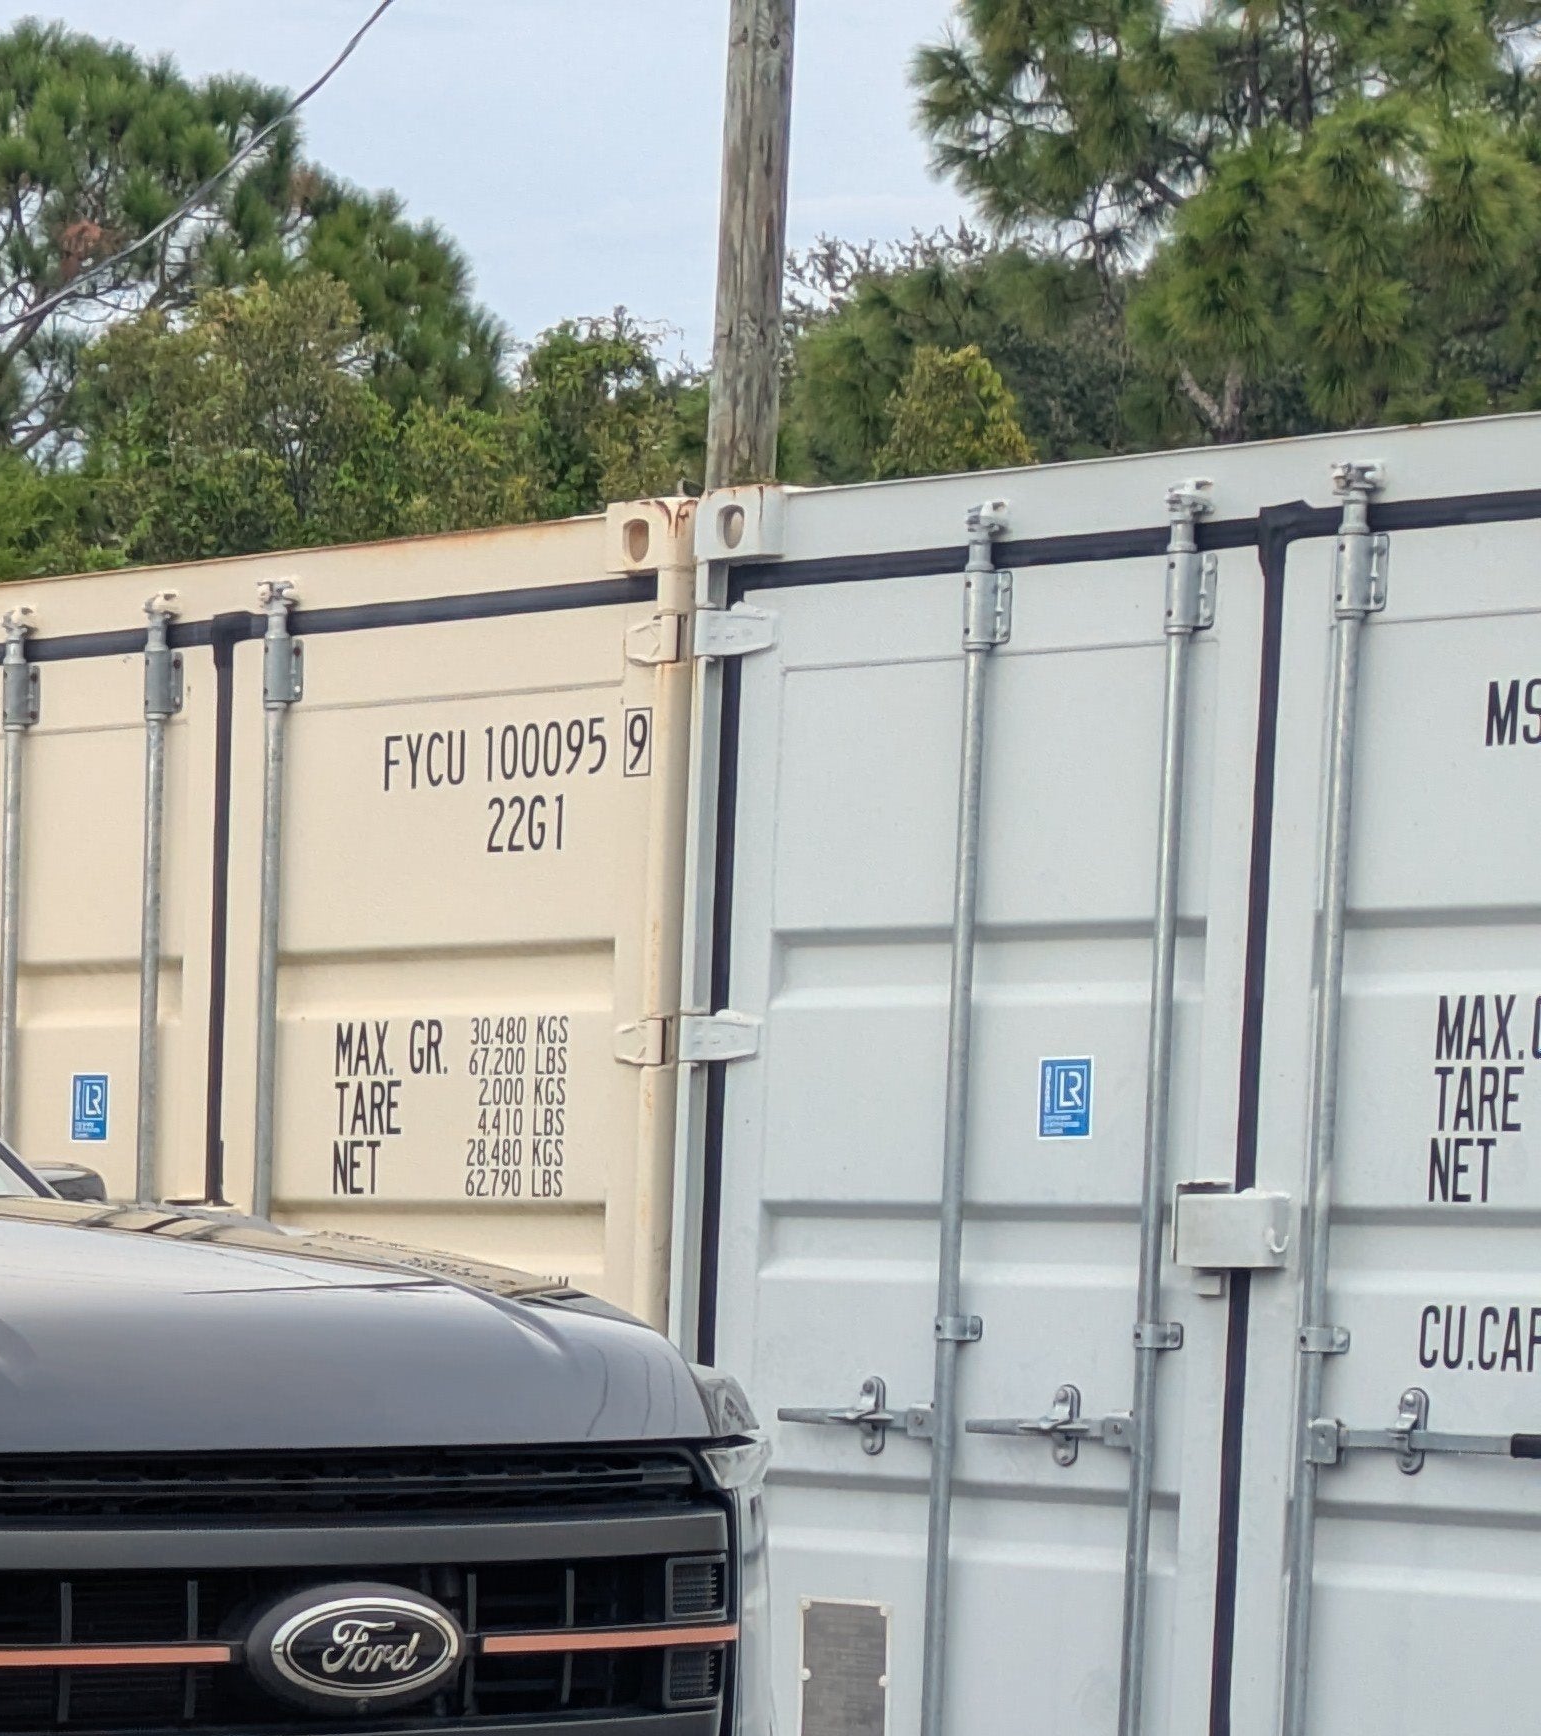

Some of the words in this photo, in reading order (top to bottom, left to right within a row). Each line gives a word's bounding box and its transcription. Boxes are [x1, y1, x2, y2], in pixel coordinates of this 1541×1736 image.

[383, 729, 466, 791] FYCU
[484, 717, 607, 782] 100095
[628, 711, 649, 773] 9
[486, 794, 565, 853] 22G1
[335, 1021, 394, 1077] MAX.
[409, 1019, 449, 1075] GR.
[470, 1016, 527, 1045] 30.480
[536, 1015, 569, 1045] KGS
[468, 1046, 526, 1076] 67.200
[534, 1046, 567, 1075] LBS
[334, 1080, 403, 1136] TARE
[533, 1076, 566, 1106] KGS
[477, 1107, 524, 1137] 4.410
[532, 1107, 565, 1137] LBS
[1435, 1066, 1525, 1132] TARE
[332, 1140, 382, 1195] NET
[466, 1138, 522, 1167] 28.480
[531, 1137, 564, 1168] KGS
[531, 1168, 564, 1198] LBS
[1427, 1138, 1497, 1203] NET
[322, 1619, 421, 1674] Ford
